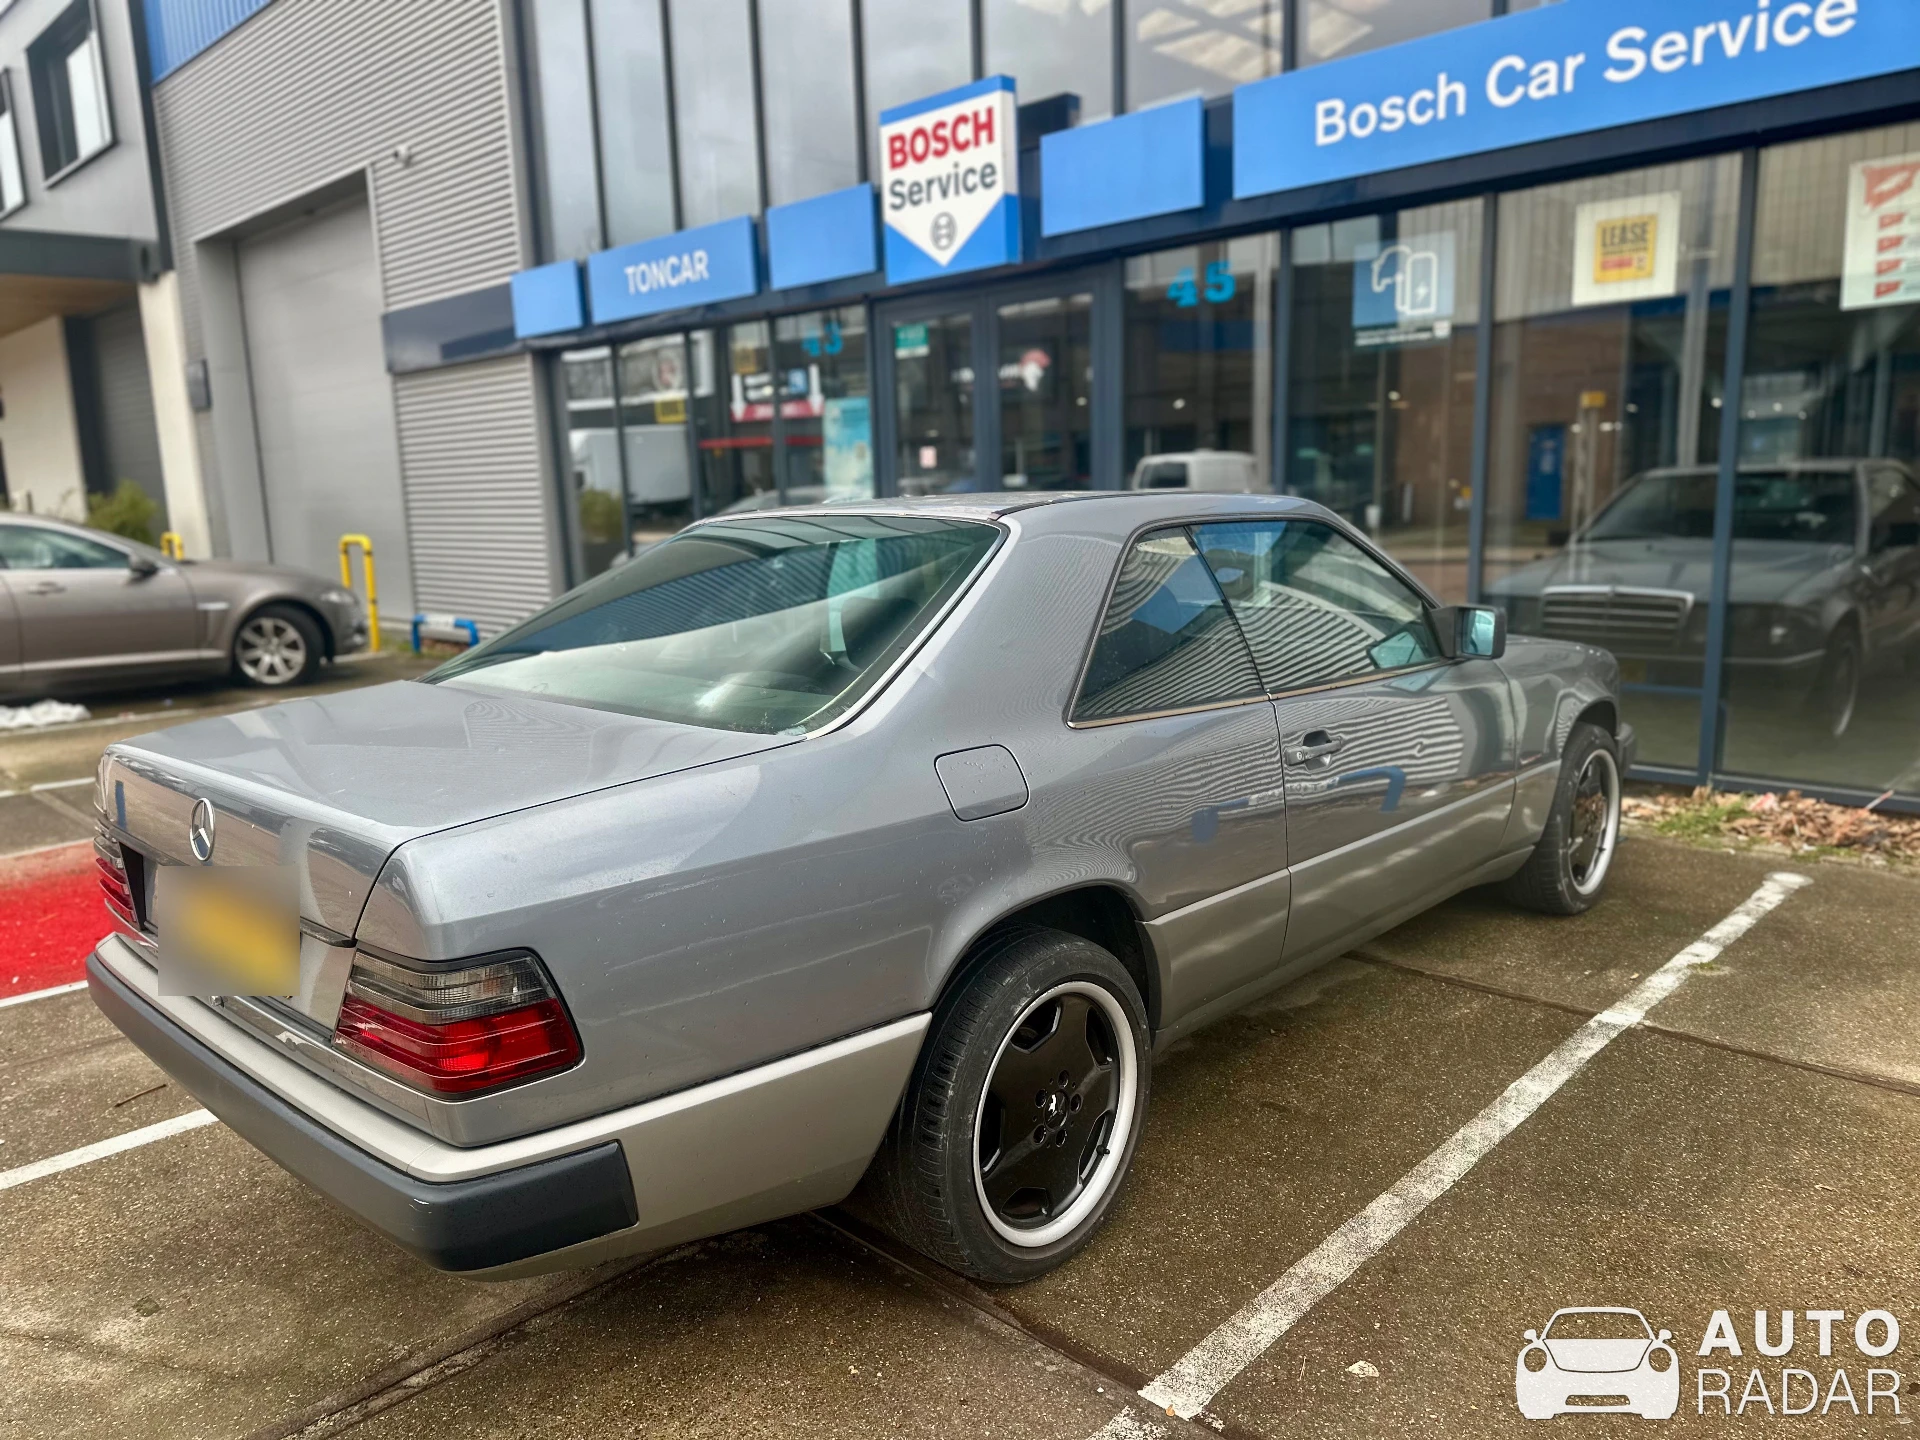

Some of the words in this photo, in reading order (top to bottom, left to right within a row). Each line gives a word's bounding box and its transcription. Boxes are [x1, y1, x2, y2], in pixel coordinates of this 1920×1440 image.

[1315, 72, 1467, 147] Bosch
[1486, 53, 1586, 108] Car
[1603, 0, 1859, 83] Service
[888, 105, 995, 171] BOSCH
[889, 161, 998, 211] Service
[1601, 221, 1649, 249] LEASE
[623, 248, 709, 296] TONCAR
[1167, 259, 1236, 308] 45
